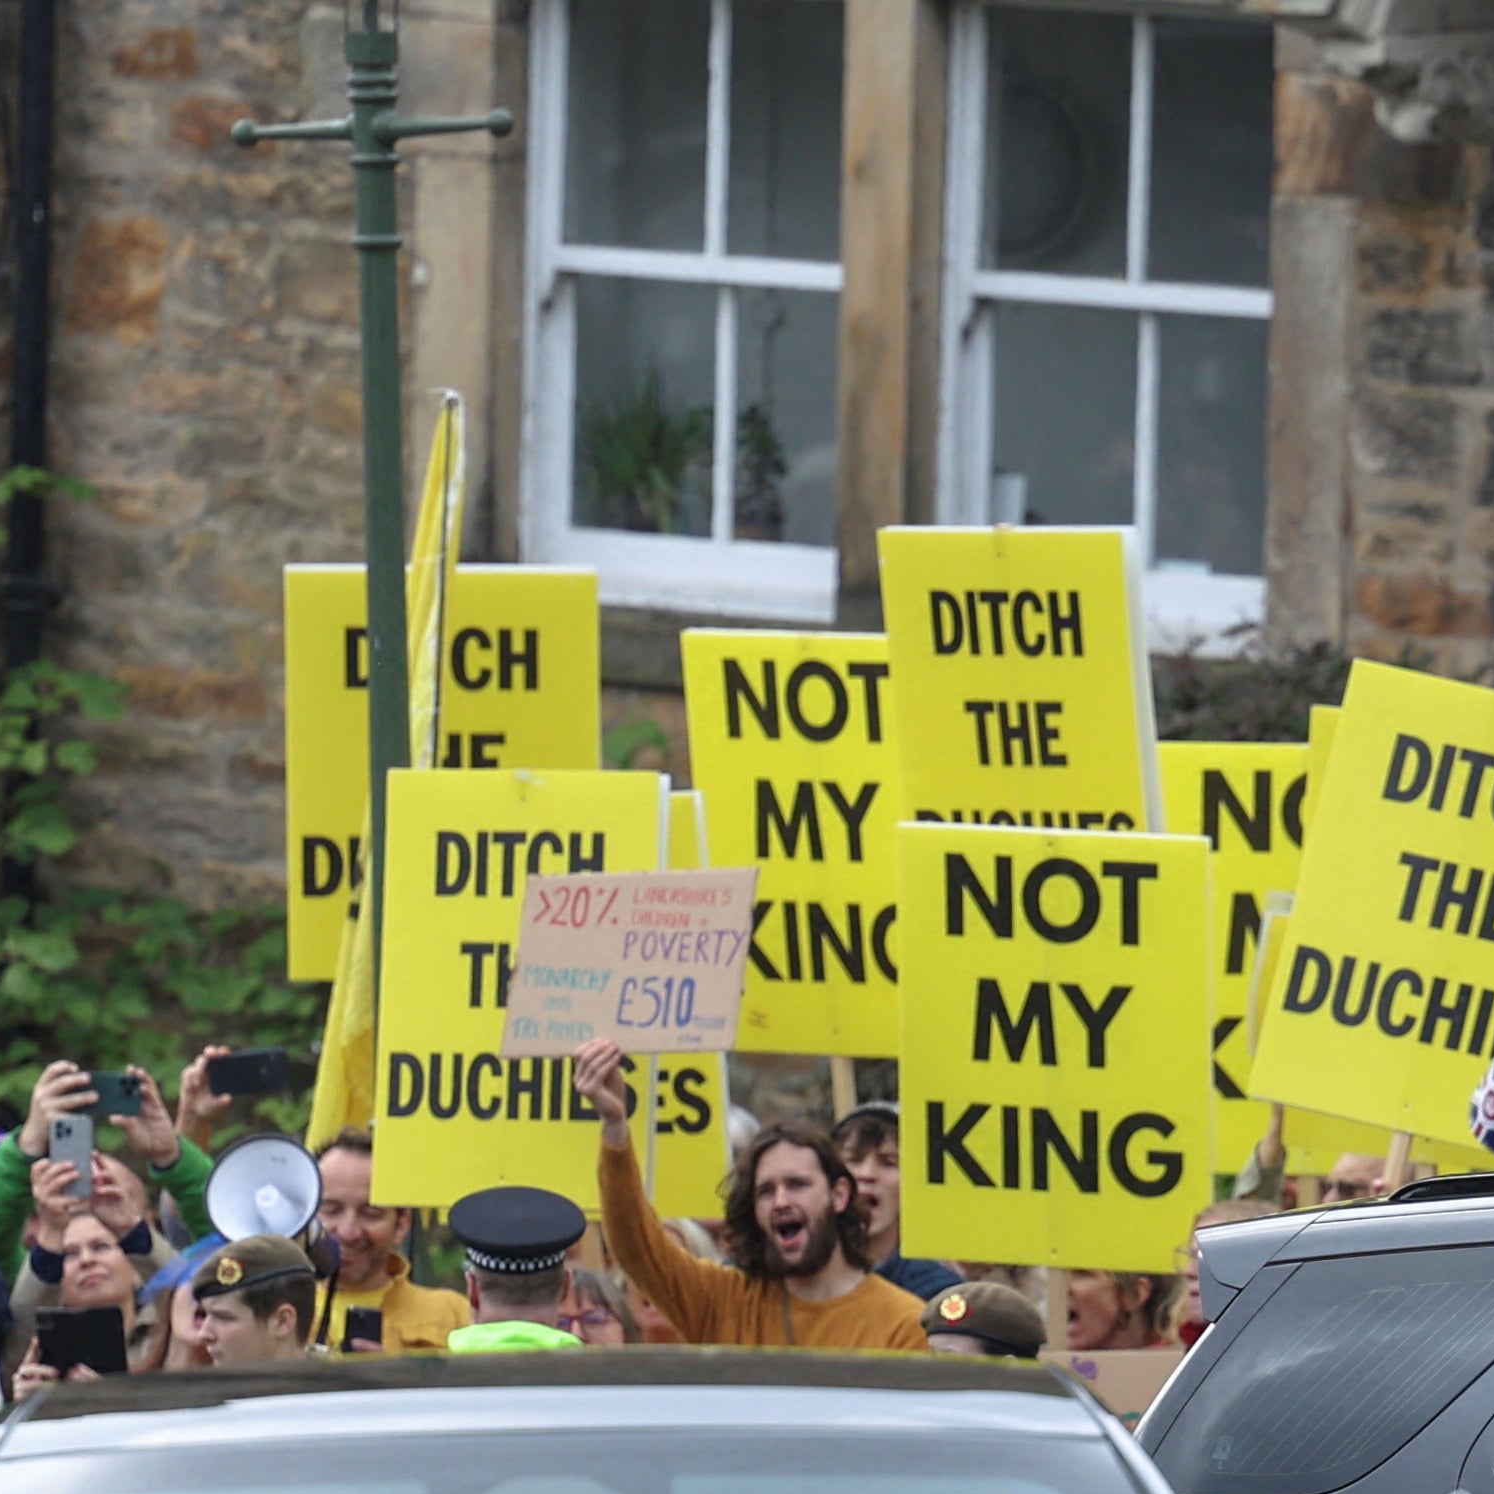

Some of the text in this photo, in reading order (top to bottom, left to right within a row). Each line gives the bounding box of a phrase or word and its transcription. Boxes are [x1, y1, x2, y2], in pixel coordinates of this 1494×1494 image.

[929, 589, 1084, 657] DITCH
[345, 627, 539, 691] DCH
[722, 658, 890, 743] NOT
[964, 700, 1069, 767] THE
[756, 778, 881, 862] MY
[434, 830, 605, 898] DITCH
[532, 885, 620, 929] >20%
[945, 852, 1159, 947] NOT
[622, 928, 747, 968] POVERTY
[616, 974, 696, 1029] £510
[971, 977, 1134, 1069] MY
[925, 1099, 1184, 1198] KING
